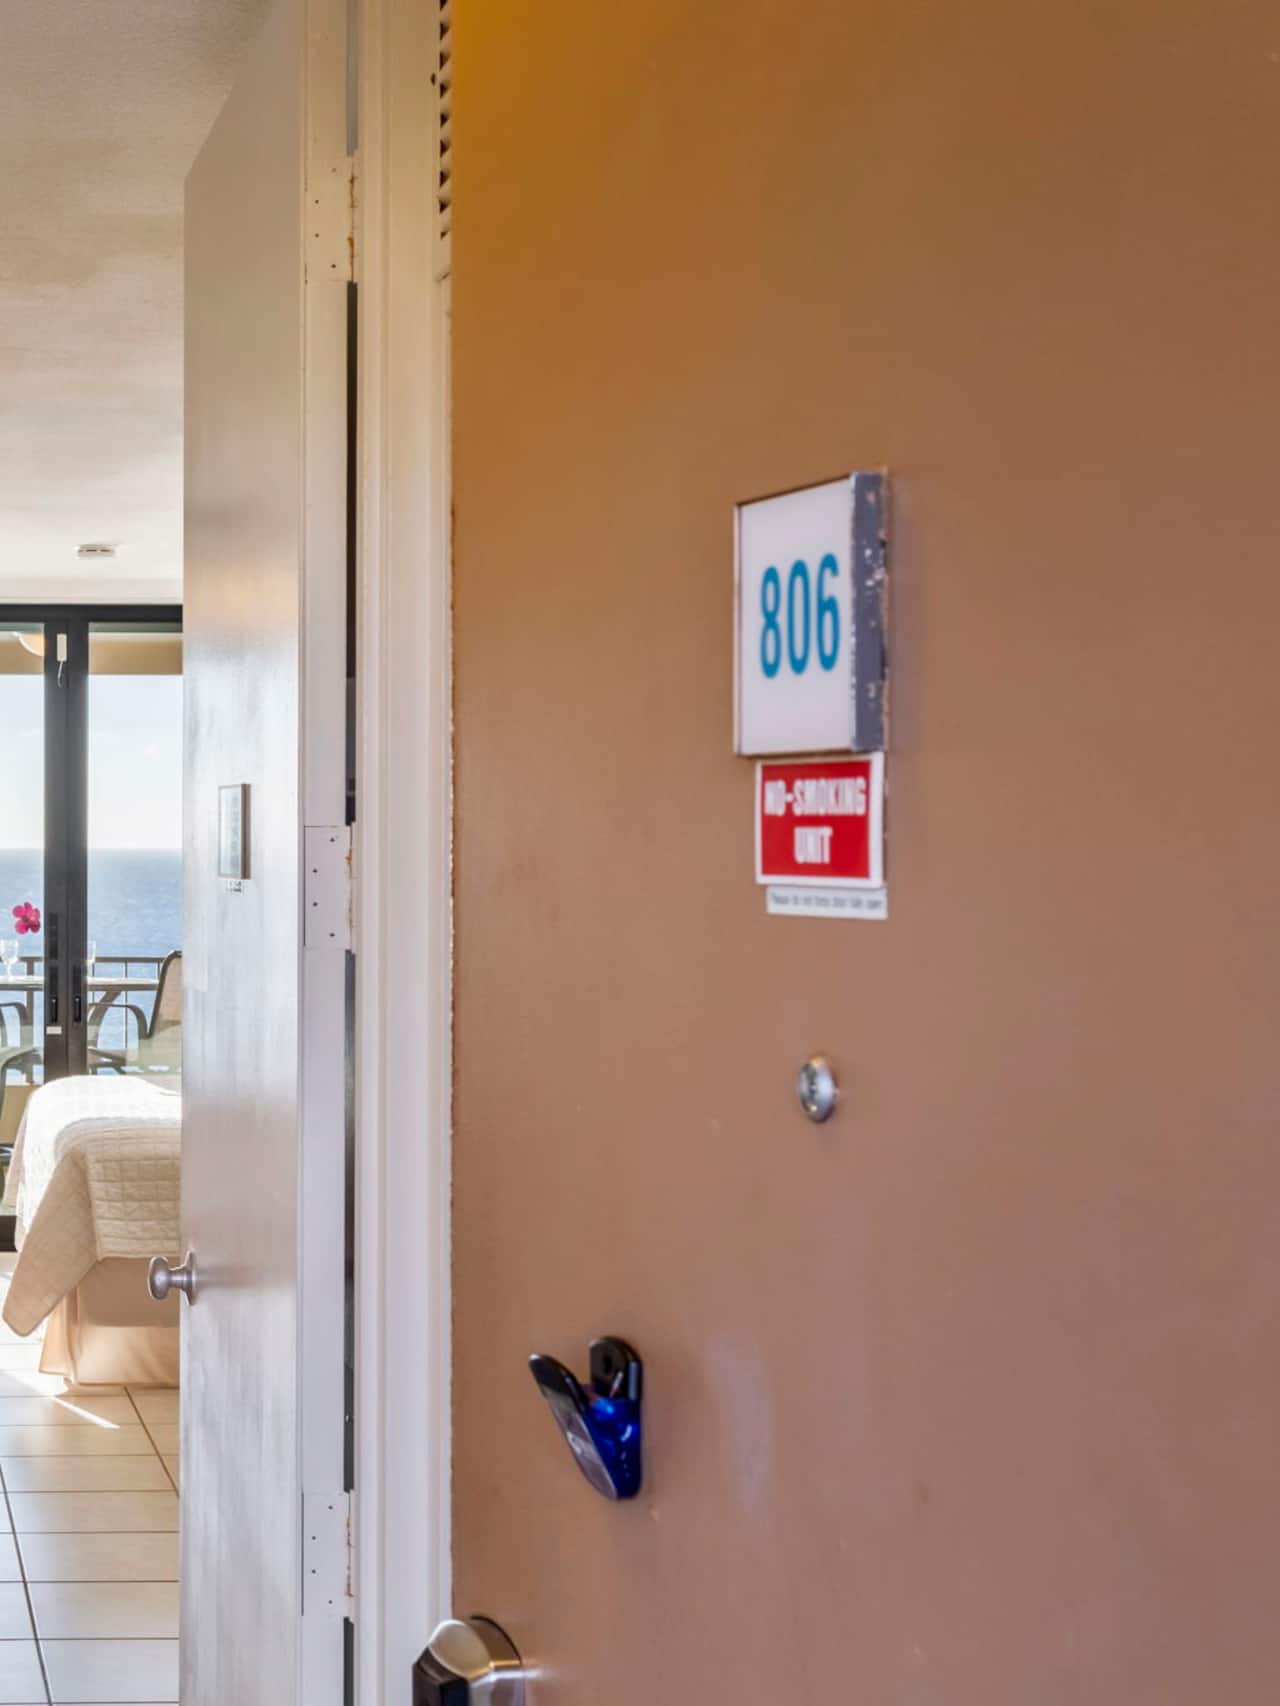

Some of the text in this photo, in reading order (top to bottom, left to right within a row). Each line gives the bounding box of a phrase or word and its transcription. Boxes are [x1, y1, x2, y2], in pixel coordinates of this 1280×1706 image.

[760, 553, 840, 679] 806
[764, 776, 867, 816] NO-SMOKING
[794, 825, 833, 864] UNIT
